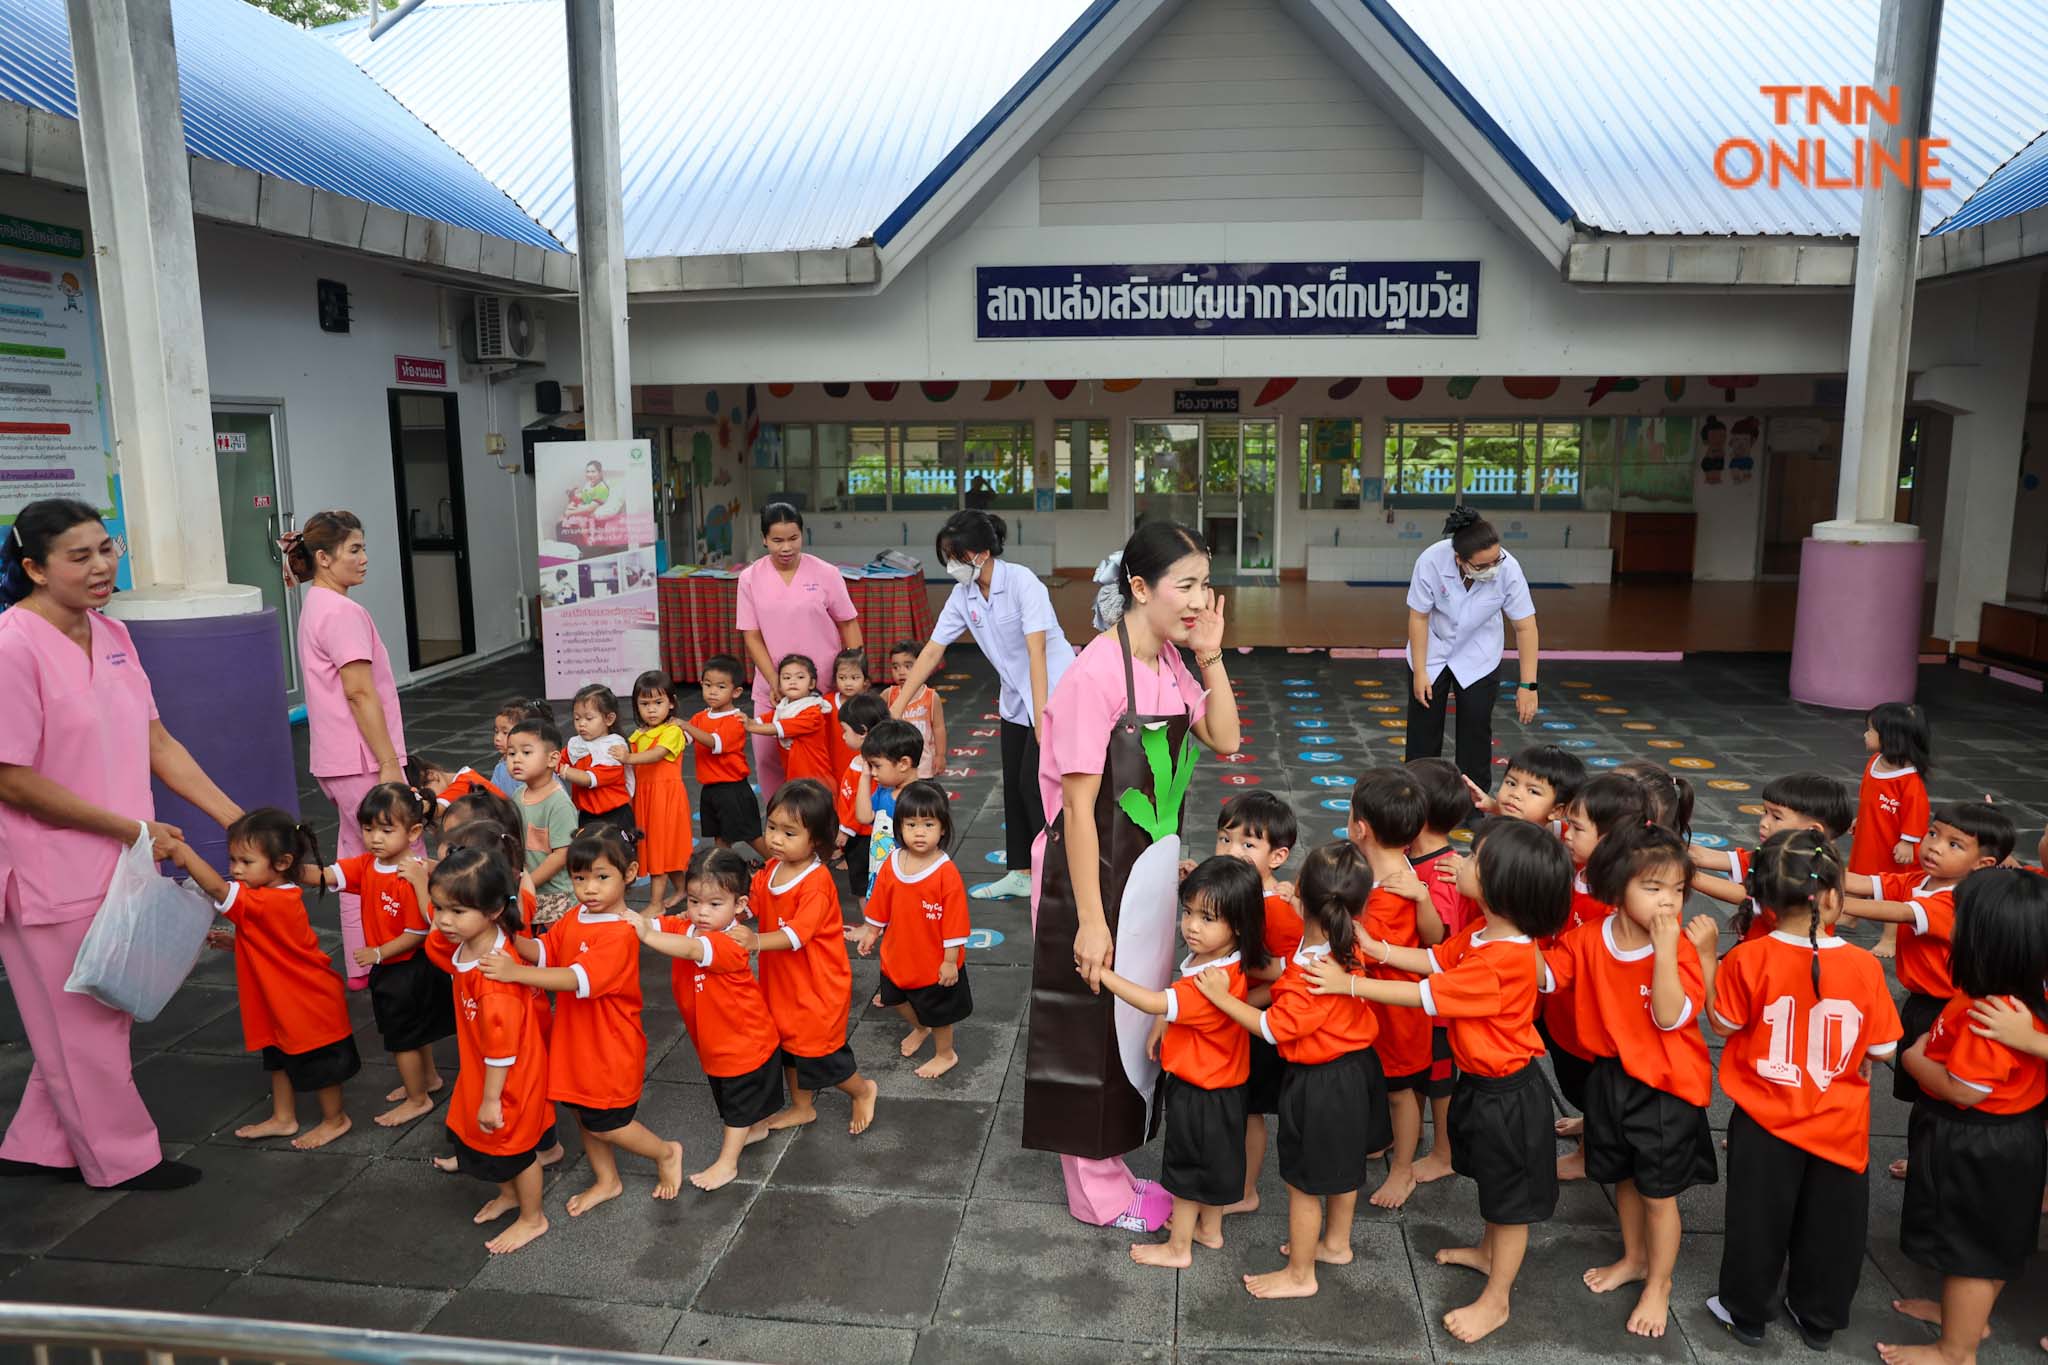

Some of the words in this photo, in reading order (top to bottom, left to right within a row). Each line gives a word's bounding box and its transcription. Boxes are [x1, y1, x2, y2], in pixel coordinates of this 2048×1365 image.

[986, 266, 1469, 330] สถานส่งเสริมพัฒนาการเด็กปฐมวัย
[1175, 392, 1238, 410] ห้องอาหาร
[922, 900, 934, 912] Day
[1757, 995, 1865, 1093] 10
